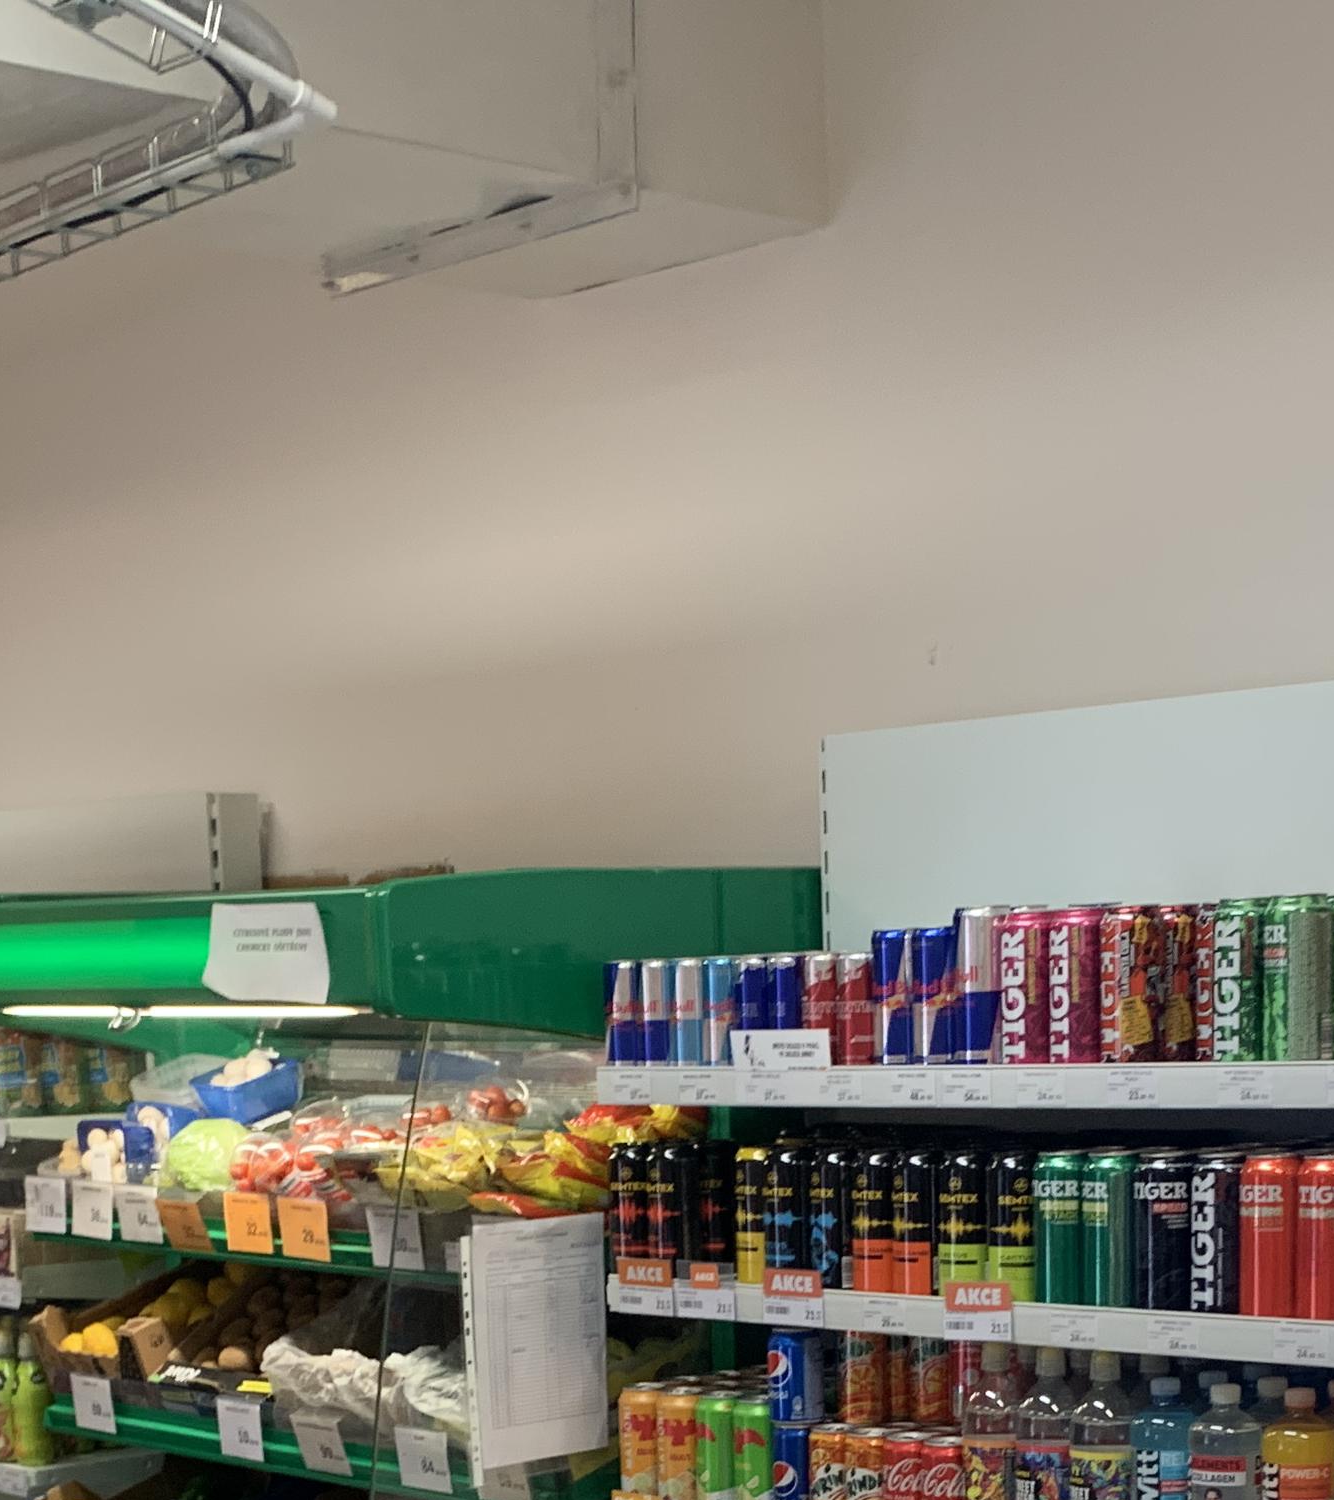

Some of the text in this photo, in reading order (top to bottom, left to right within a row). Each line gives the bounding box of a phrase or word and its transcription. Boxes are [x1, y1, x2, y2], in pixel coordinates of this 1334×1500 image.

[1002, 928, 1025, 1062] TIGER
[1049, 927, 1070, 1062] TIGER
[1213, 915, 1241, 1060] TIGER
[626, 1265, 664, 1283] AKCE
[1190, 1172, 1215, 1312] TIGER
[771, 1275, 814, 1294] AKCE
[955, 1287, 1002, 1307] AKCE
[1280, 1467, 1331, 1480] POWER-C
